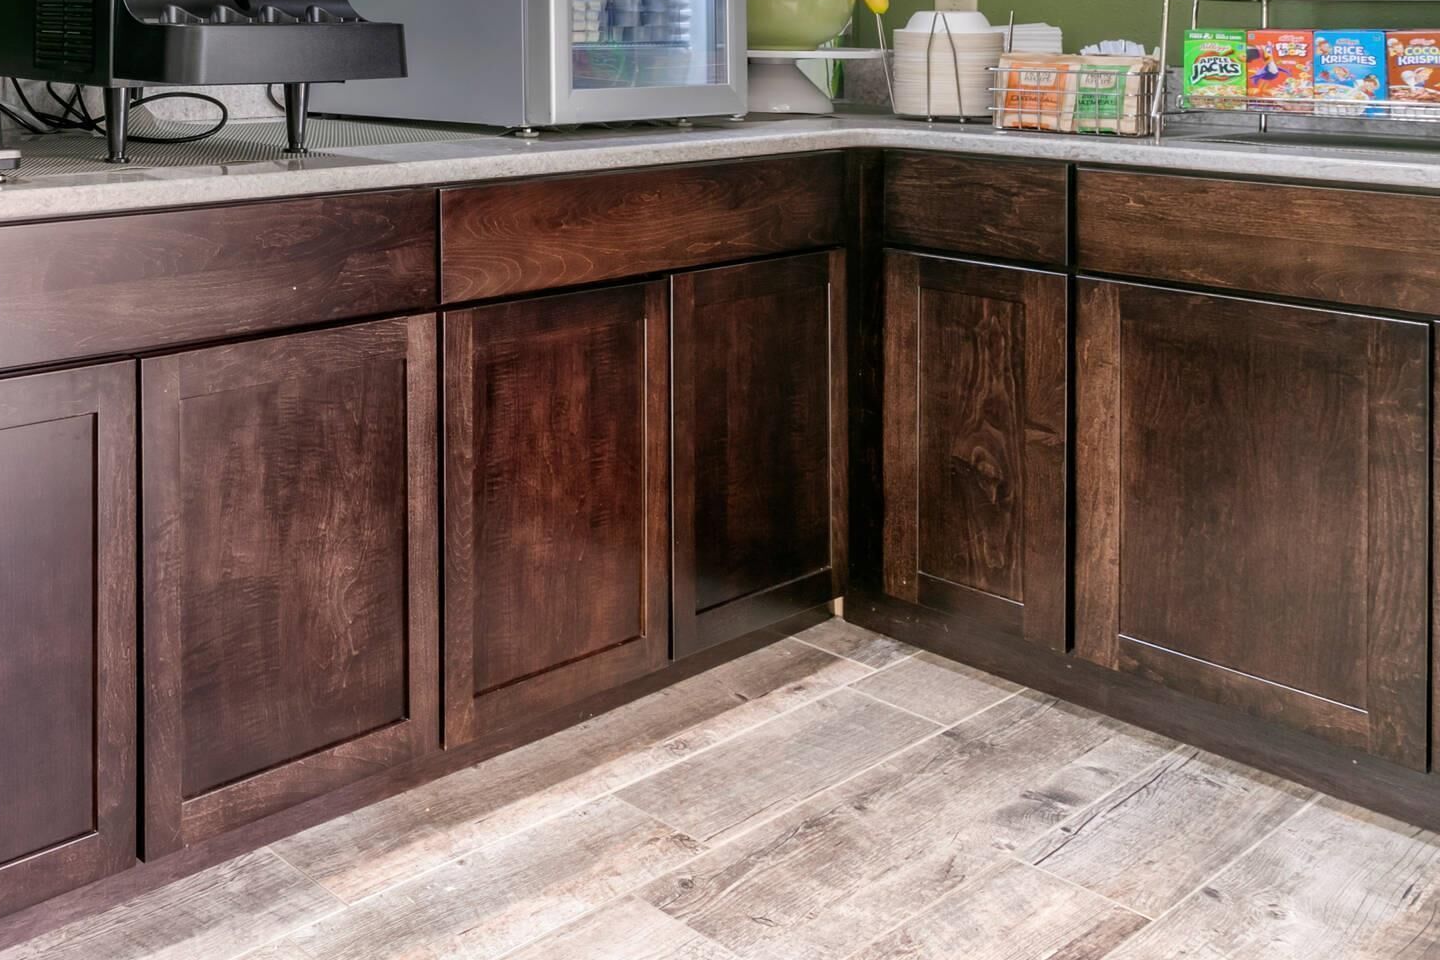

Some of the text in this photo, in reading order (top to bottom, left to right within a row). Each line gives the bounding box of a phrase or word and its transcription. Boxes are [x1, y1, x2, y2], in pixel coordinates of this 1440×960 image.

[1333, 46, 1364, 55] RICE
[1404, 46, 1440, 56] COCO
[1200, 56, 1229, 64] APPLE
[1321, 54, 1377, 65] KRISPIES
[1191, 62, 1242, 84] JACKS
